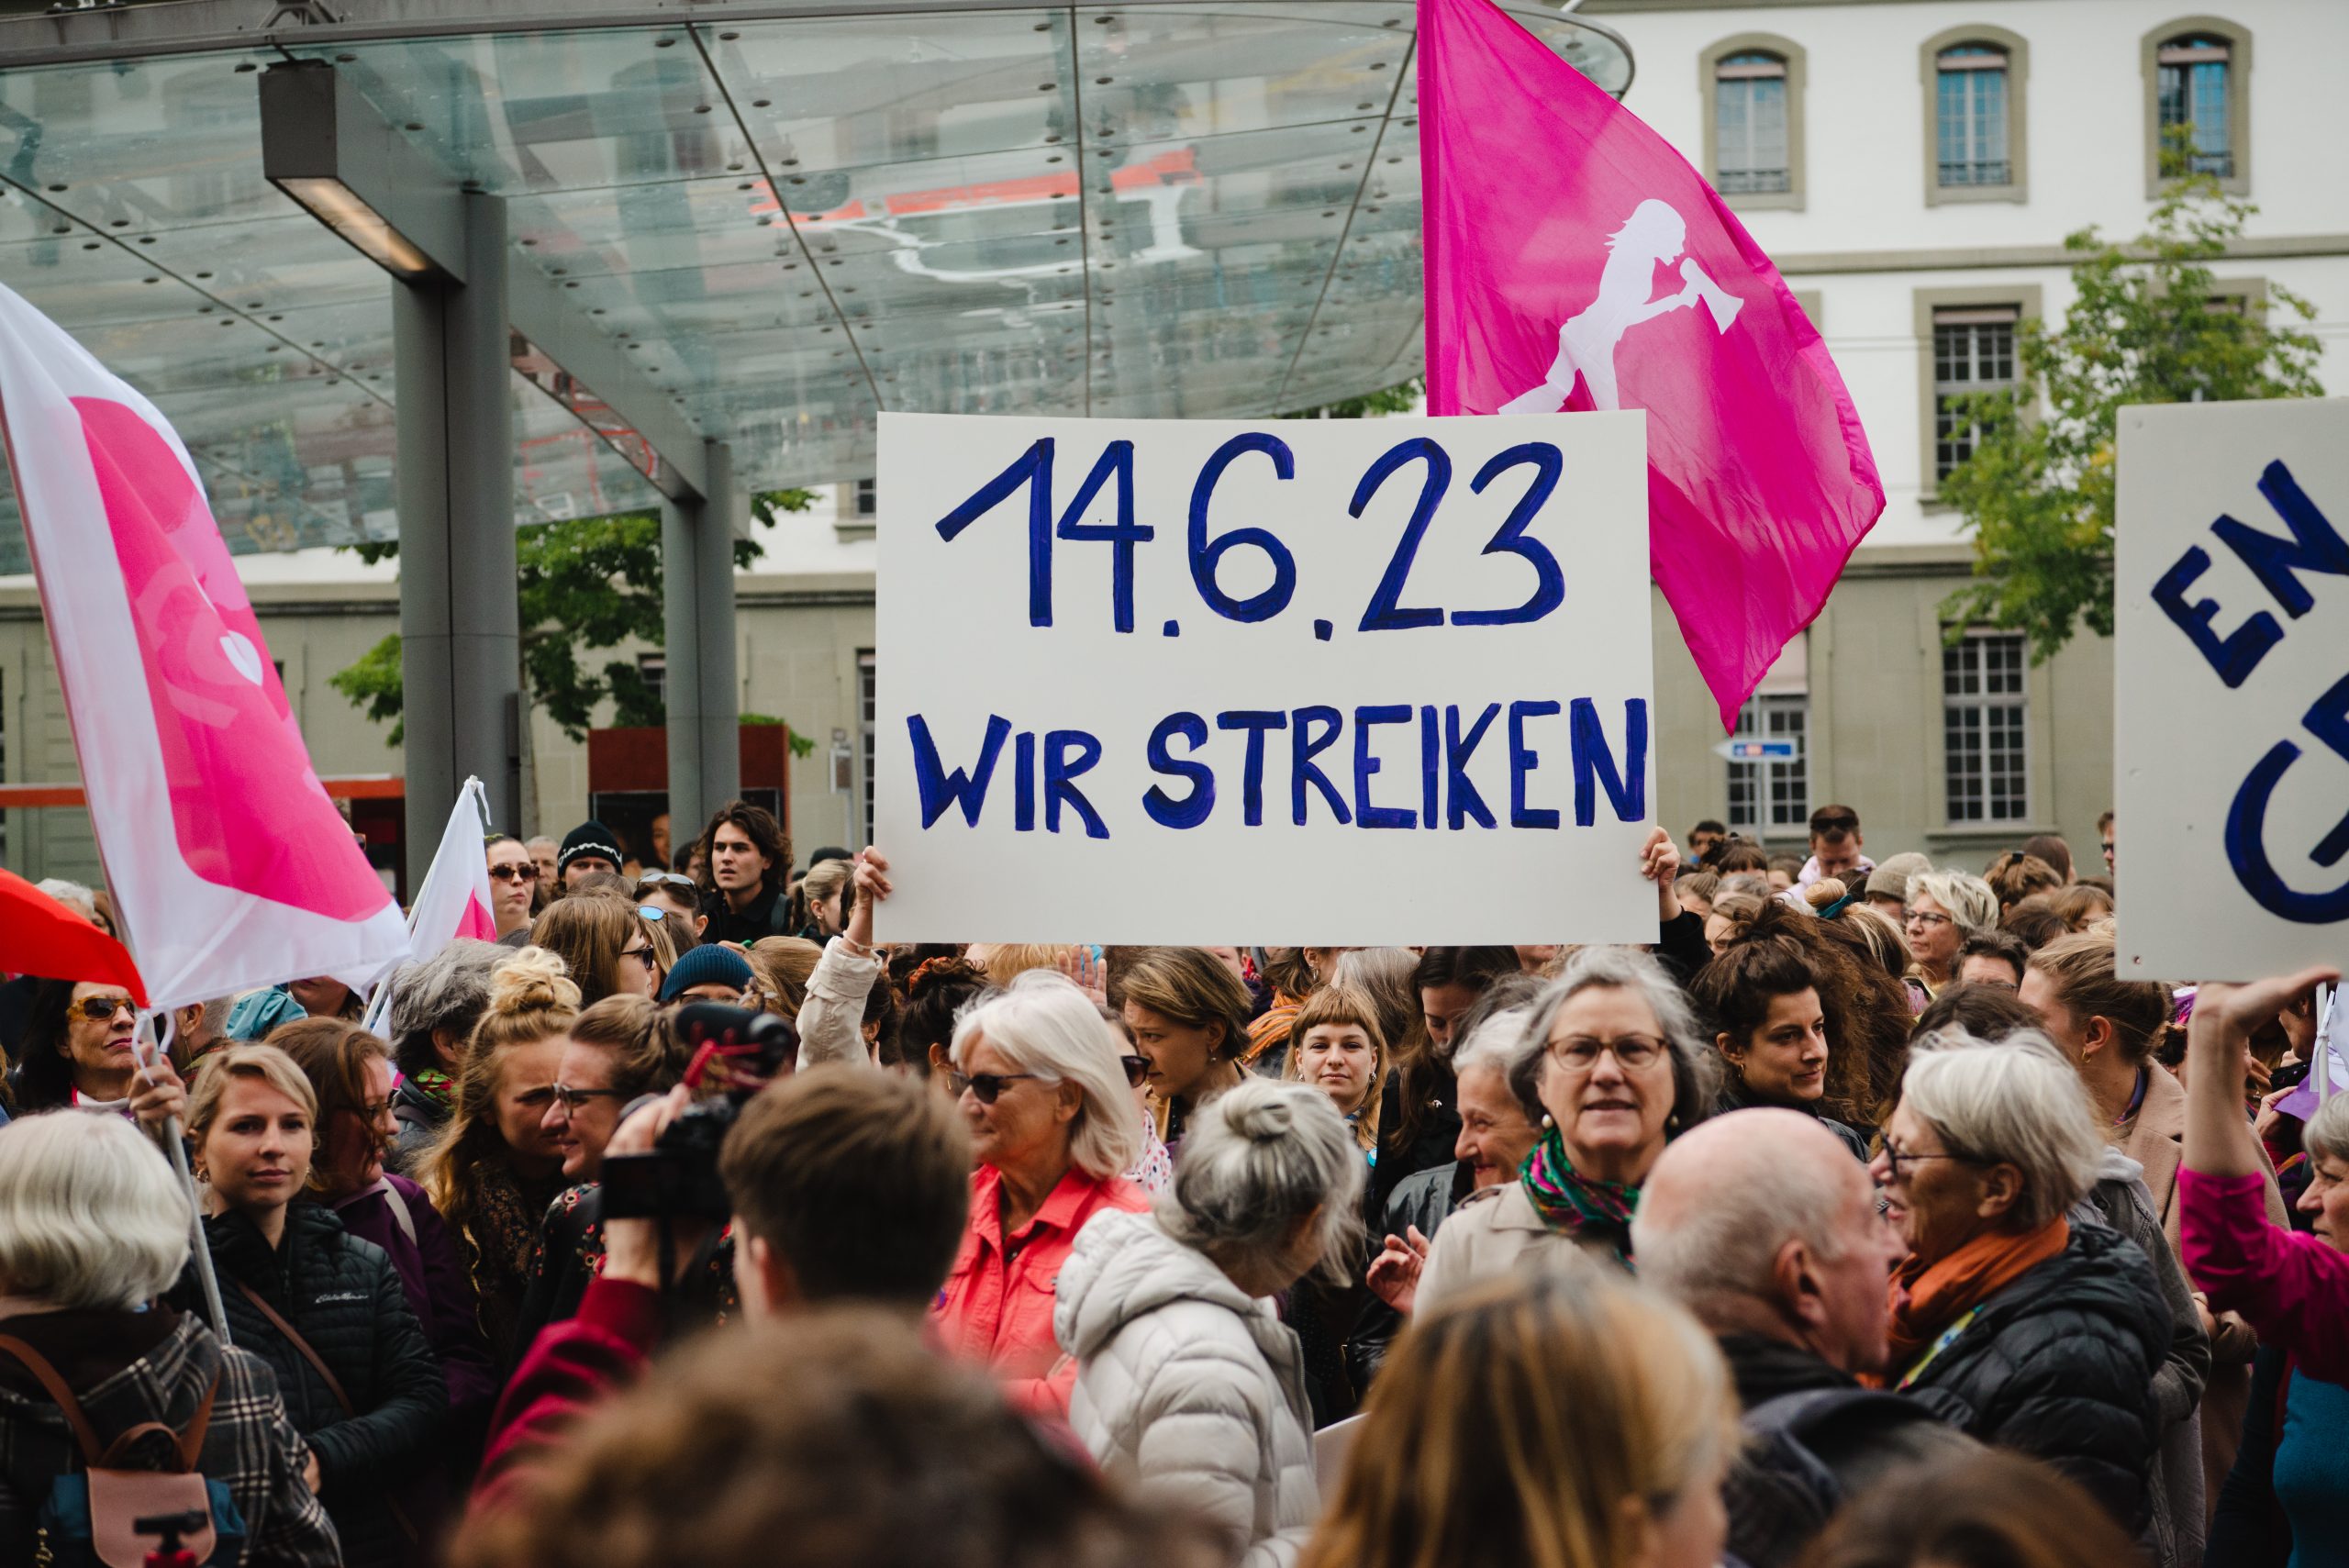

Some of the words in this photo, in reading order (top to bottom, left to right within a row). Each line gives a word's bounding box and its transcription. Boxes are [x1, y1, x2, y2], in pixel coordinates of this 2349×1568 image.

[936, 432, 1565, 639] 14.6.23
[906, 713, 1110, 840] WIR
[1141, 696, 1649, 831] STREIKEN
